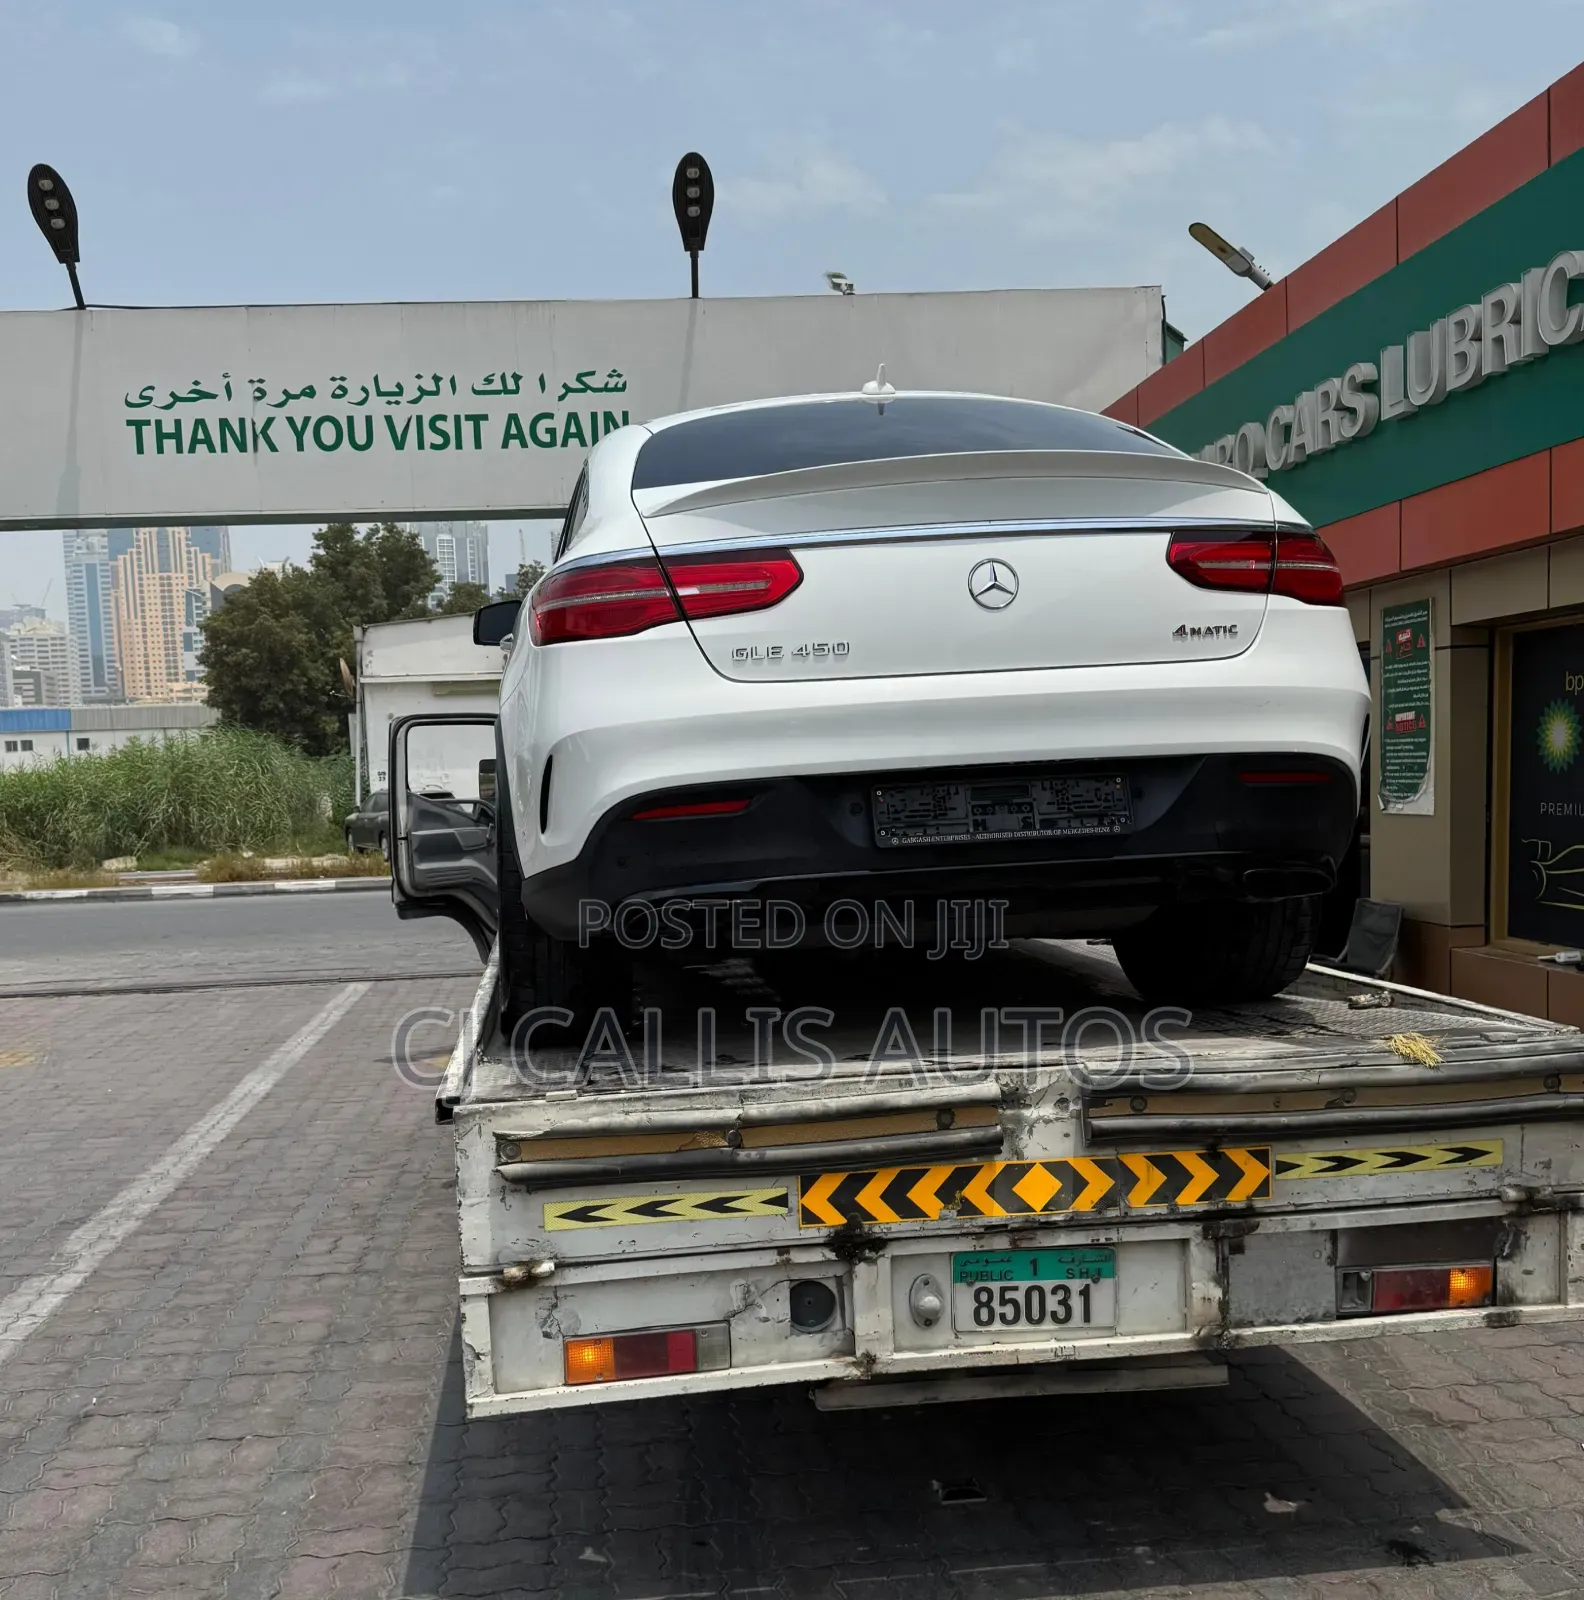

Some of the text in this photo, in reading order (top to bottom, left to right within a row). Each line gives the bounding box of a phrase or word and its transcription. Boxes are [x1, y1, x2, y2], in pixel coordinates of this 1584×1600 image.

[1265, 362, 1380, 471] CARS
[1380, 250, 1584, 422] LUBRIC
[124, 372, 233, 410] أخرى
[248, 378, 317, 408] مرة
[329, 371, 457, 406] الزيارة
[471, 371, 523, 396] لك
[125, 416, 279, 455] THANK
[285, 414, 374, 453] YOU
[384, 413, 489, 451] VISIT
[1172, 624, 1238, 637] 4MATIC
[731, 641, 850, 661] GLE 450
[1565, 671, 1584, 695] bp
[960, 1269, 1014, 1282] PUBLIC
[1030, 1257, 1038, 1277] 1
[973, 1283, 1092, 1327] 85031
